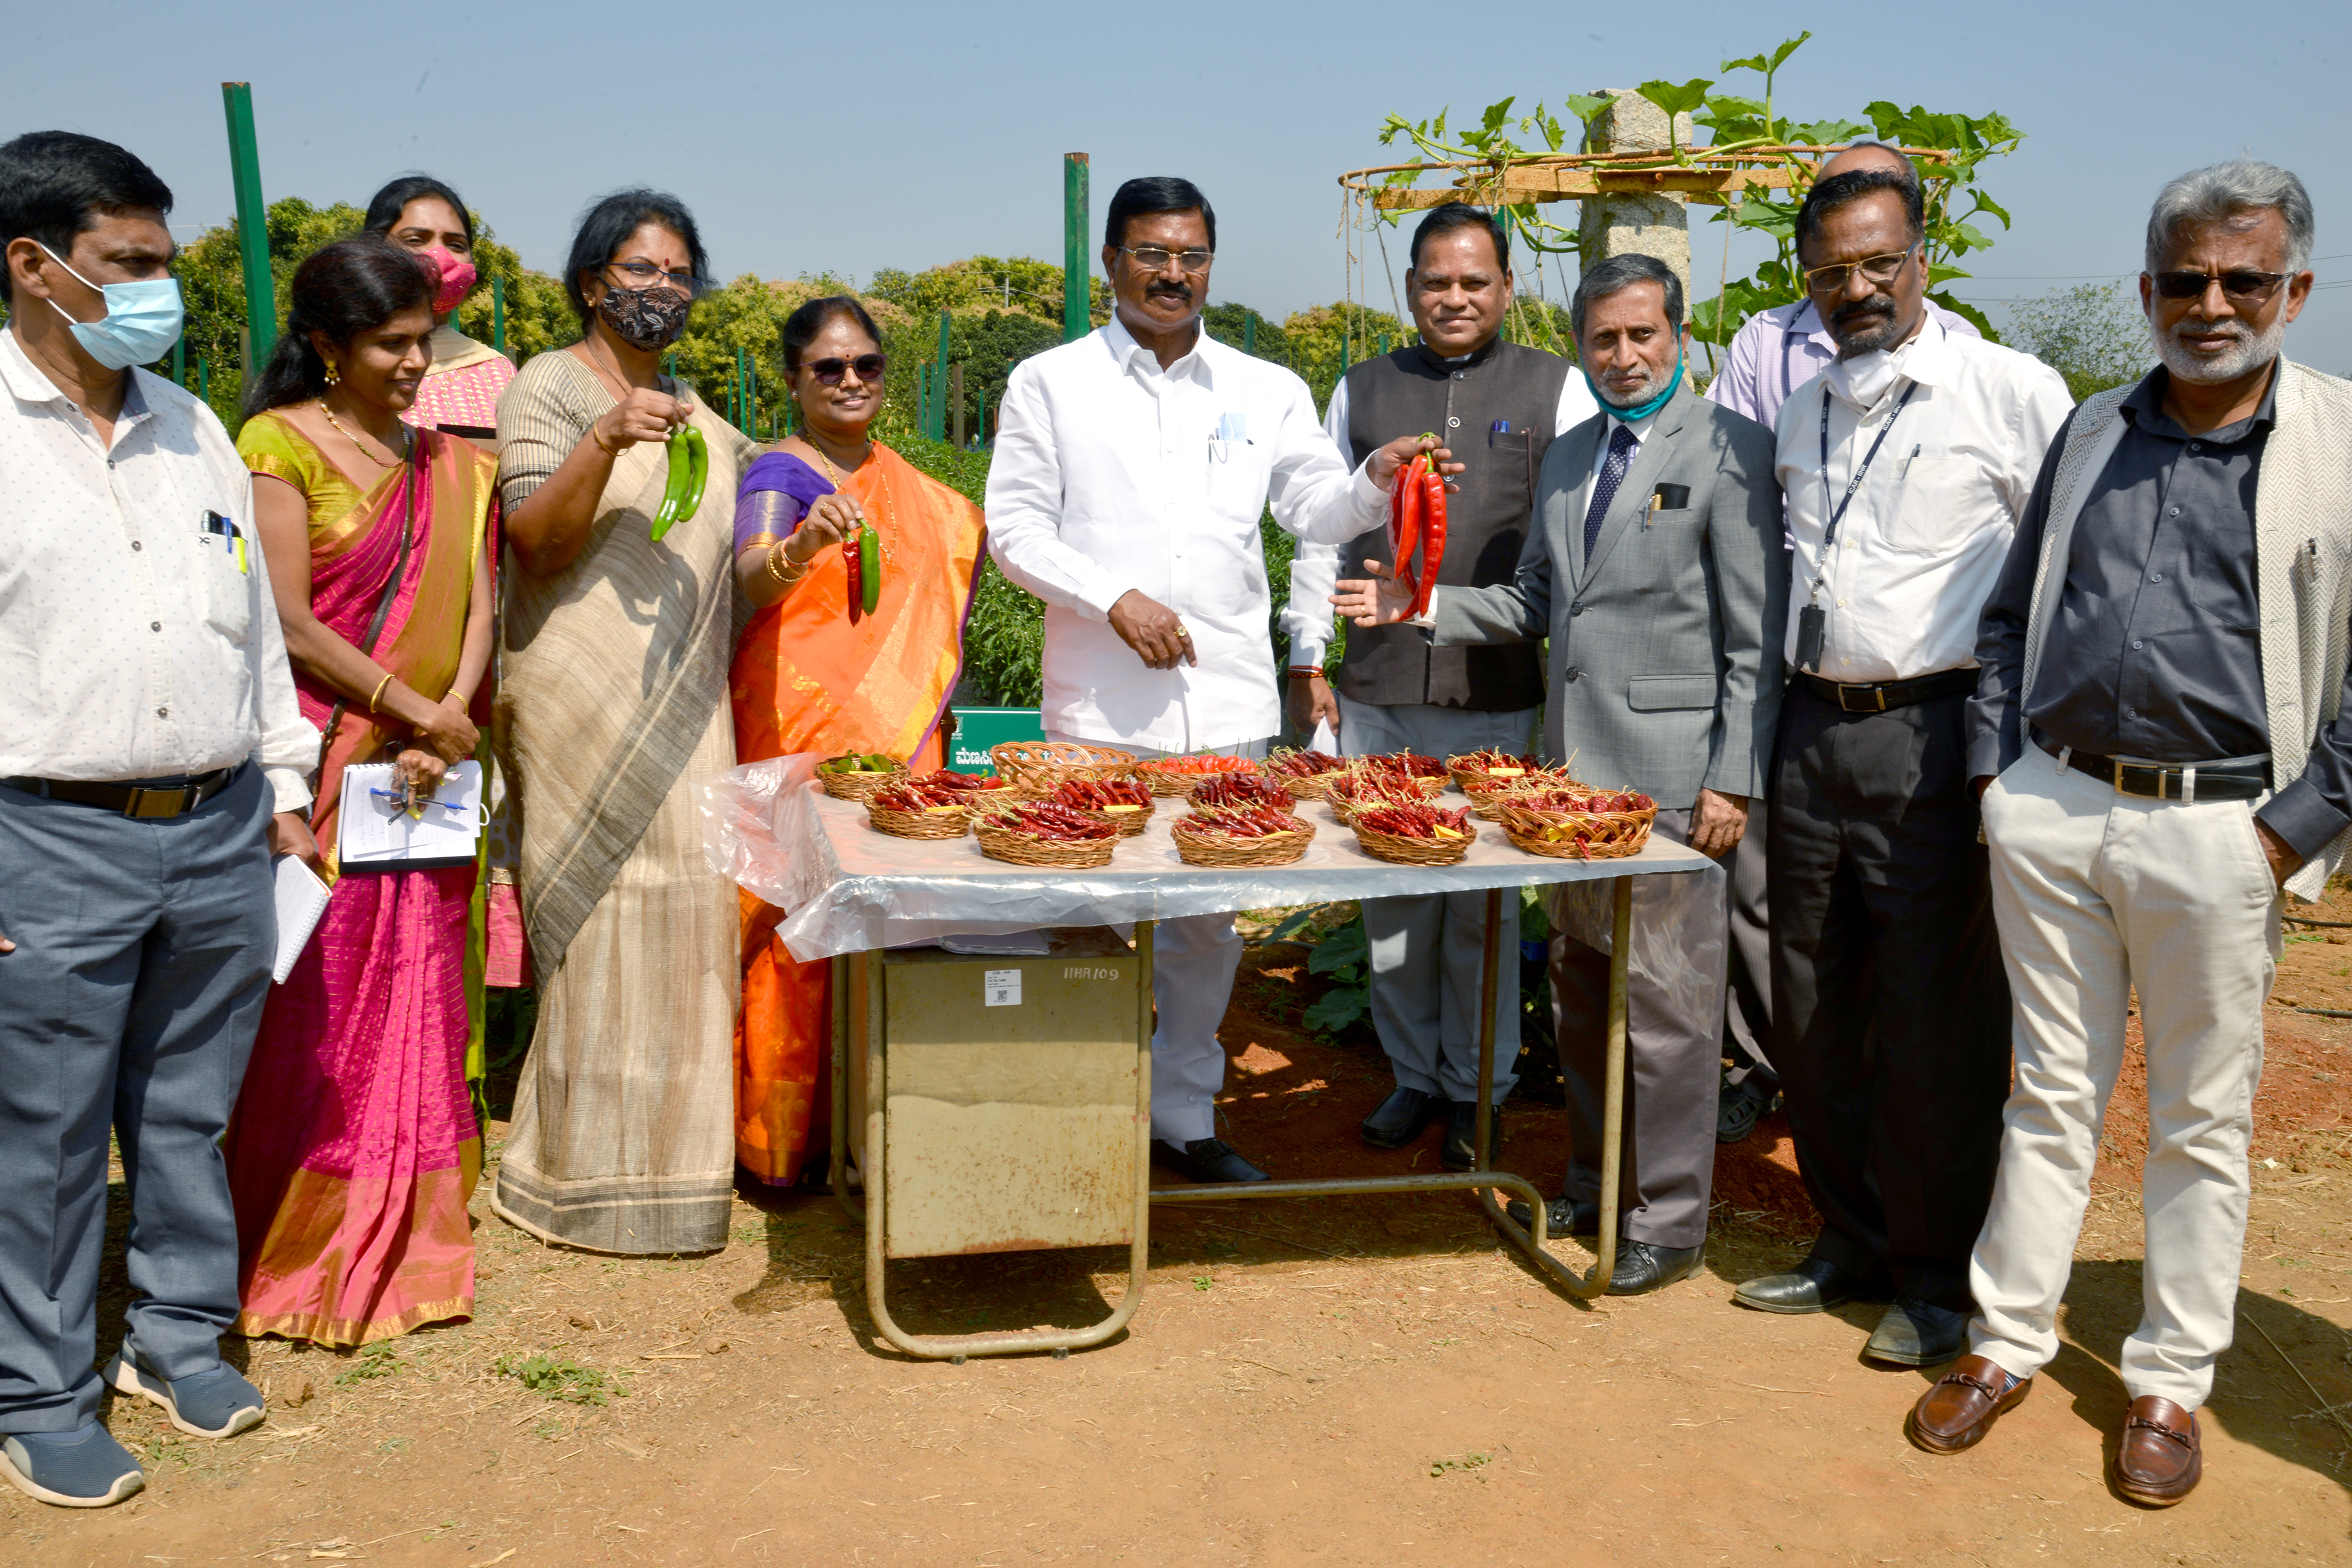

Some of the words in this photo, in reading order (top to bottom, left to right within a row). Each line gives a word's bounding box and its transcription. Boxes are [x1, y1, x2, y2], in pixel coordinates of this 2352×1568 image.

[1882, 417, 1894, 431] ICAR
[1848, 480, 1859, 494] ICAR
[1857, 465, 1867, 476] IIHR
